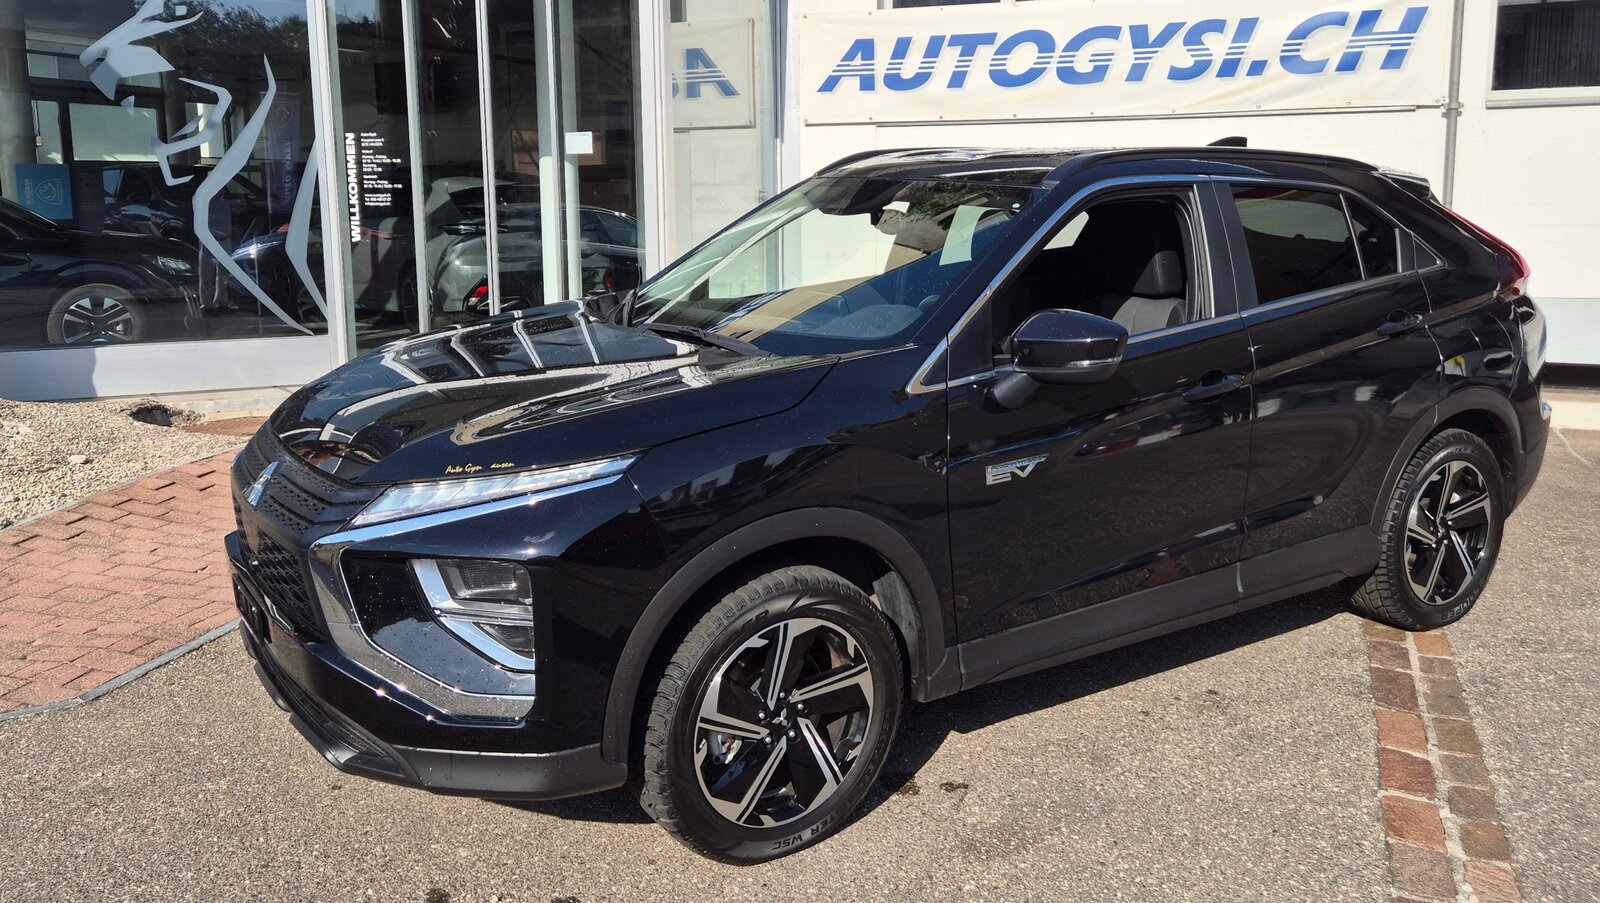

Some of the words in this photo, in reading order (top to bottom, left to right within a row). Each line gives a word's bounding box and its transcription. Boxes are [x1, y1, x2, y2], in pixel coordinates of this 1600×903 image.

[816, 6, 1430, 93] AUTOGYSI.CH
[345, 132, 361, 243] WILLKOMMEN
[1441, 589, 1479, 620] OOPER
[771, 834, 804, 851] WSC
